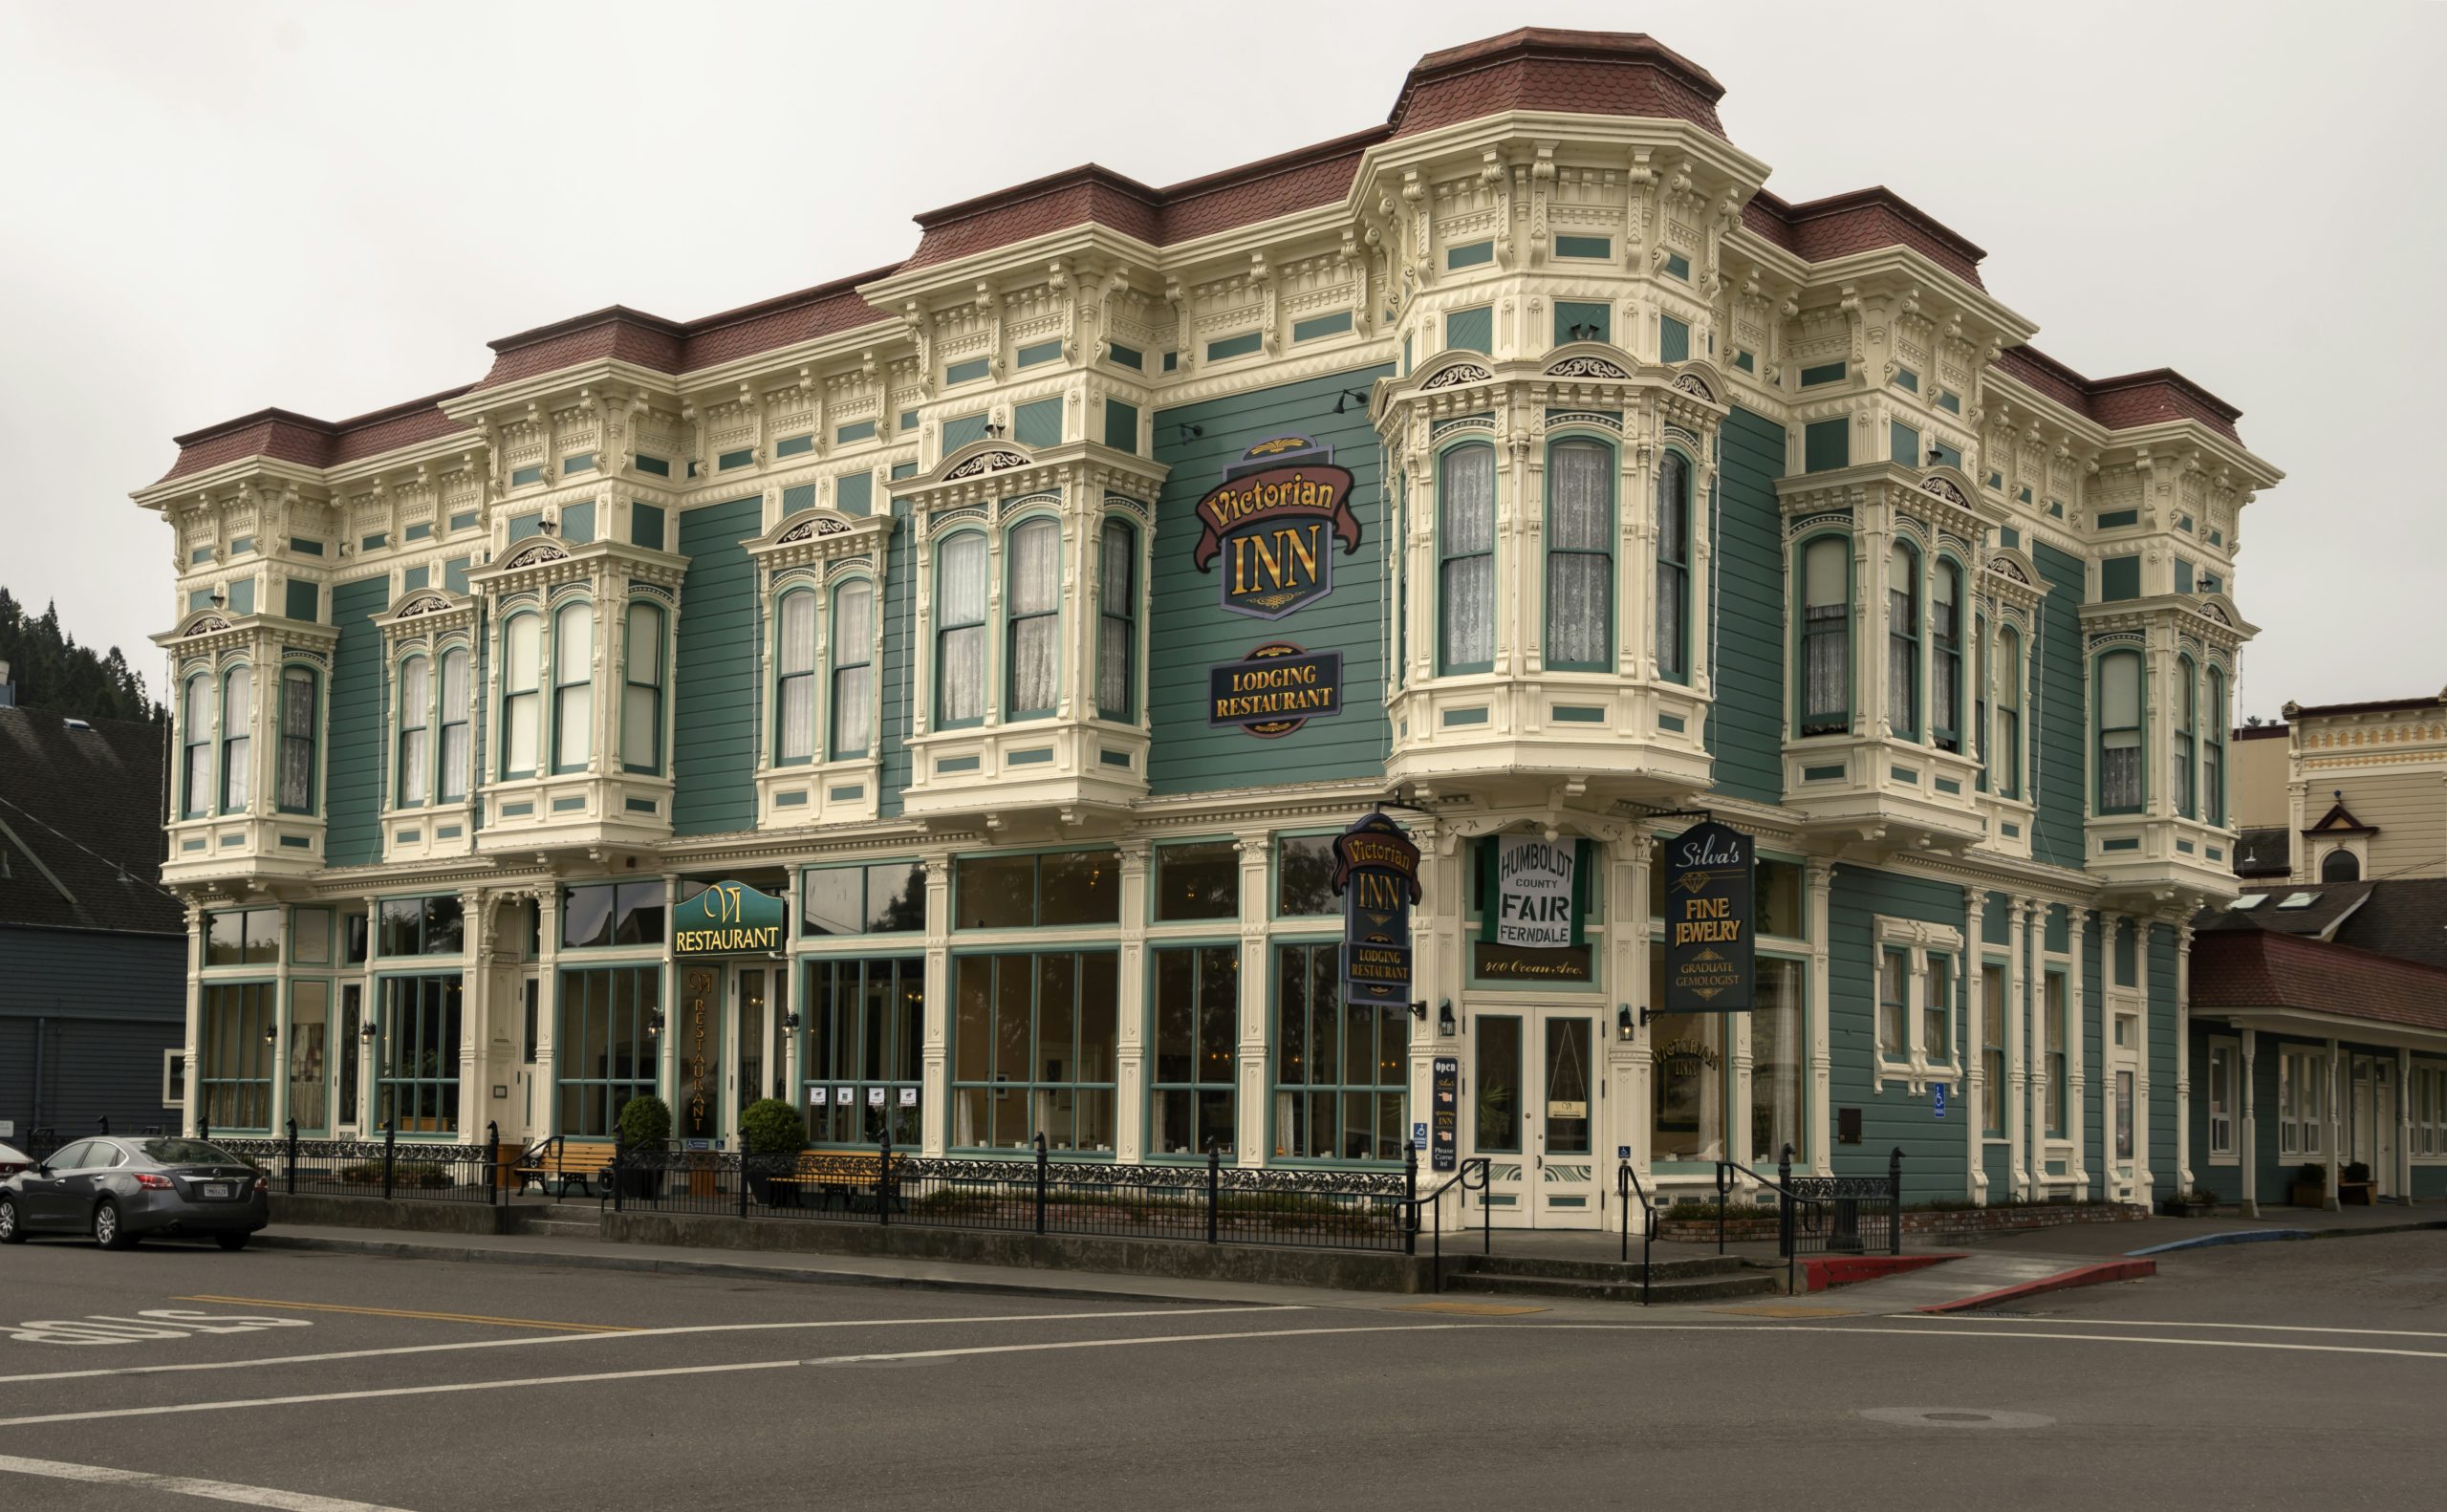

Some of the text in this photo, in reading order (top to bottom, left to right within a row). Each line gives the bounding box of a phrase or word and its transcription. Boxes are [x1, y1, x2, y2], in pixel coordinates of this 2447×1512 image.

[1206, 474, 1335, 527] Victorian
[1231, 525, 1321, 595] INN
[1233, 665, 1316, 692] LODGING
[1216, 687, 1332, 718] RESTAURANT
[1348, 839, 1412, 871] Victorian
[1501, 843, 1573, 883] HUMBOLDT
[1676, 833, 1740, 868] Silva's
[1357, 872, 1400, 911] INN
[1515, 878, 1558, 889] COUNTY
[1501, 893, 1570, 922] FAIR
[1685, 897, 1730, 919] FINE
[676, 926, 779, 952] RESTAURANT
[1500, 924, 1569, 943] FERNDALE
[1675, 919, 1741, 947] JEWELRY
[1359, 949, 1400, 964] LODGING
[1511, 959, 1549, 974] Ocean
[1680, 962, 1734, 974] GRADUATE
[1352, 962, 1408, 980] RESTAURANT
[1676, 975, 1740, 987] GEMOLOGIST
[692, 999, 705, 1132] RESTAURANT
[1435, 1062, 1456, 1073] Open
[1438, 1116, 1453, 1126] INN
[0, 1309, 314, 1346] STOP
